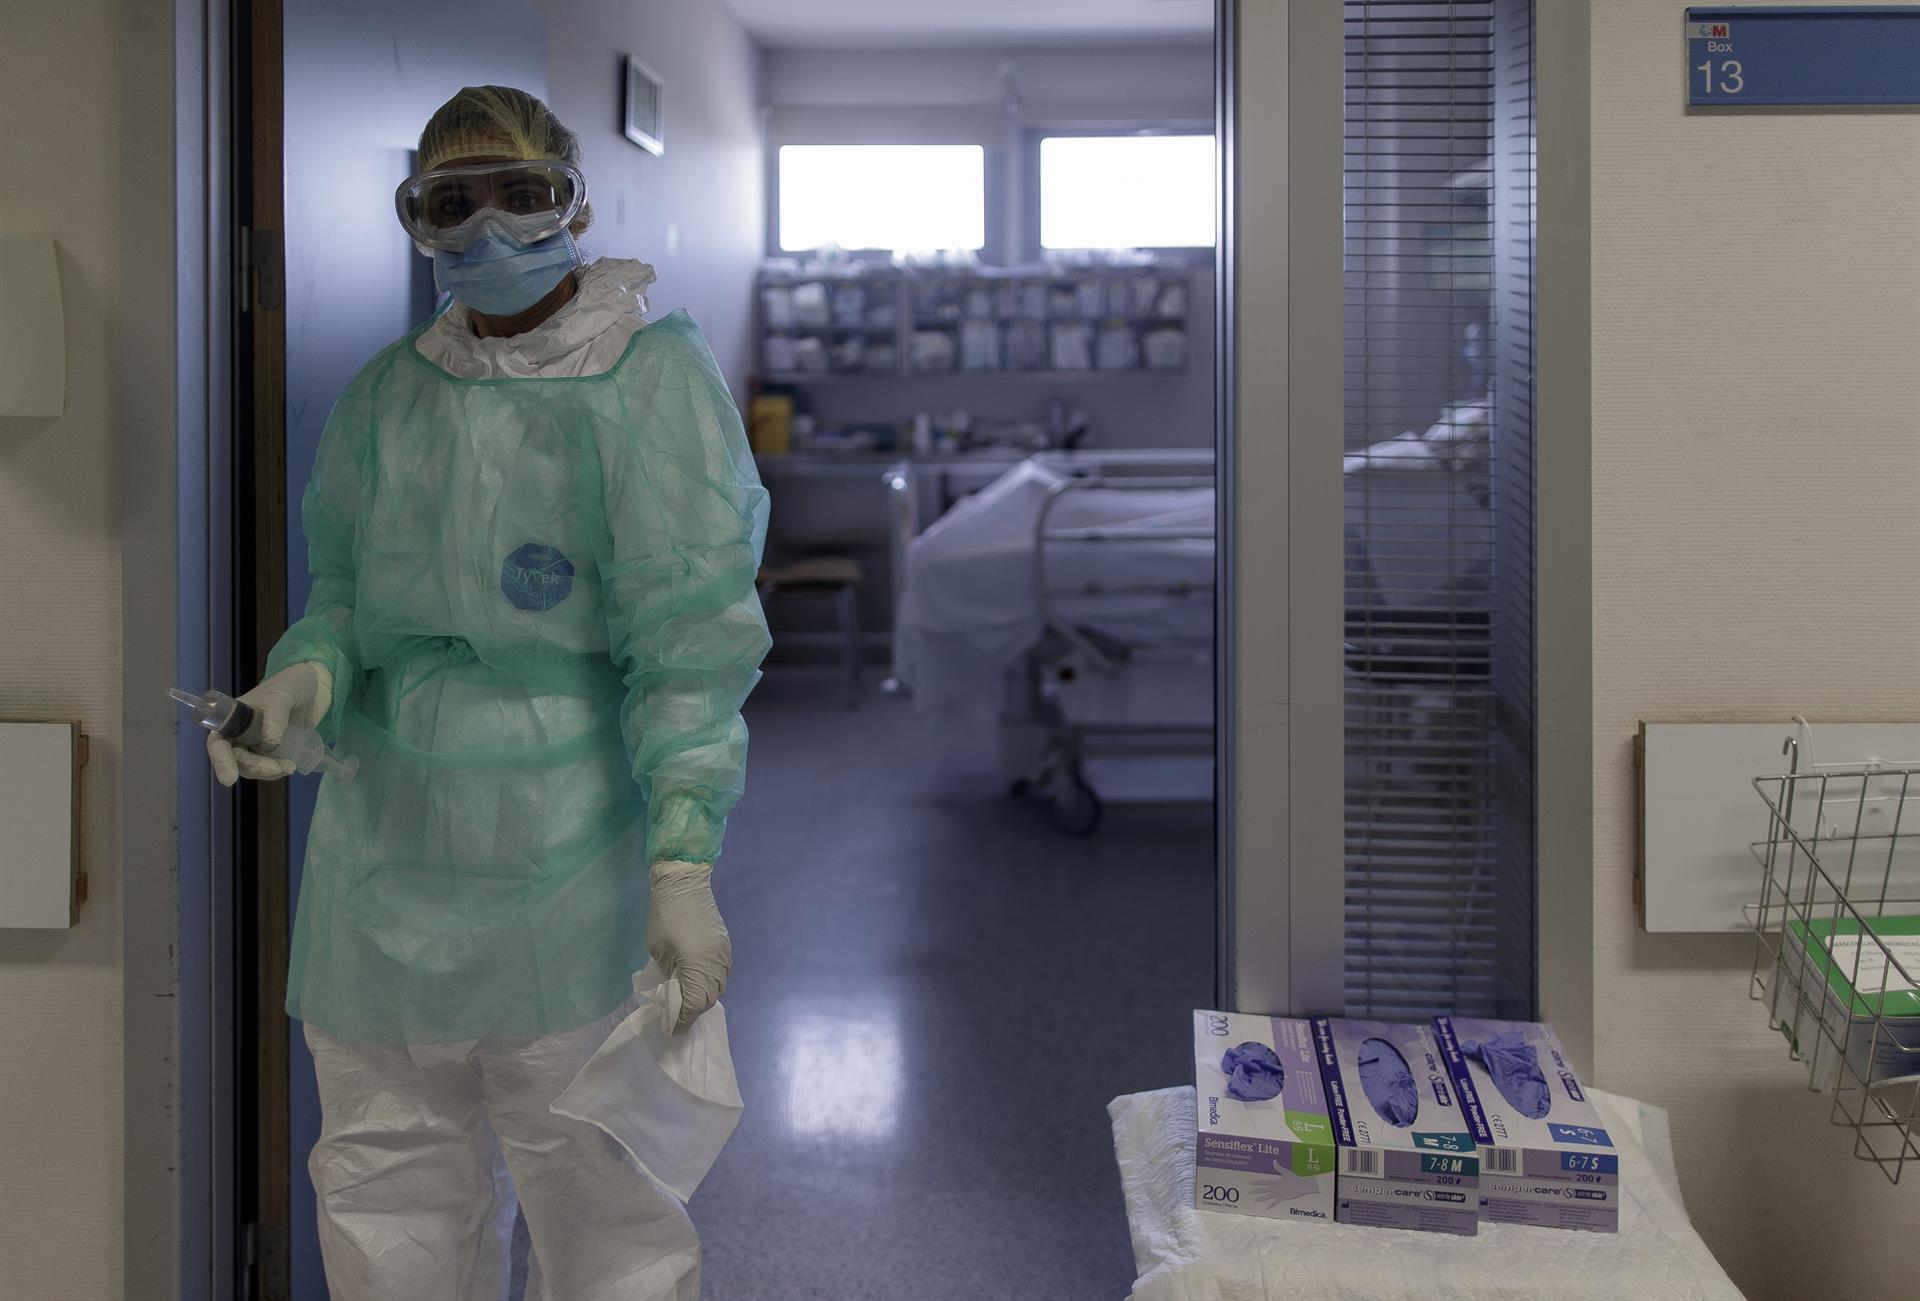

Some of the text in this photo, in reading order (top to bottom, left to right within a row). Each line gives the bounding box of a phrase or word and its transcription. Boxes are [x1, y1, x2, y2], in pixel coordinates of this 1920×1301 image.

[1707, 41, 1733, 53] Box
[1697, 60, 1744, 93] 13
[1210, 1015, 1229, 1036] 200
[1440, 1135, 1459, 1150] 7-8
[1577, 1127, 1597, 1143] 6-7
[1203, 1137, 1280, 1155] Sensiflex Lite
[1307, 1148, 1319, 1163] L
[1569, 1155, 1599, 1170] 6-7 S
[1430, 1157, 1463, 1172] 7-8 M
[1436, 1175, 1454, 1185] 200
[1576, 1173, 1594, 1183] 200
[1202, 1184, 1240, 1202] 200
